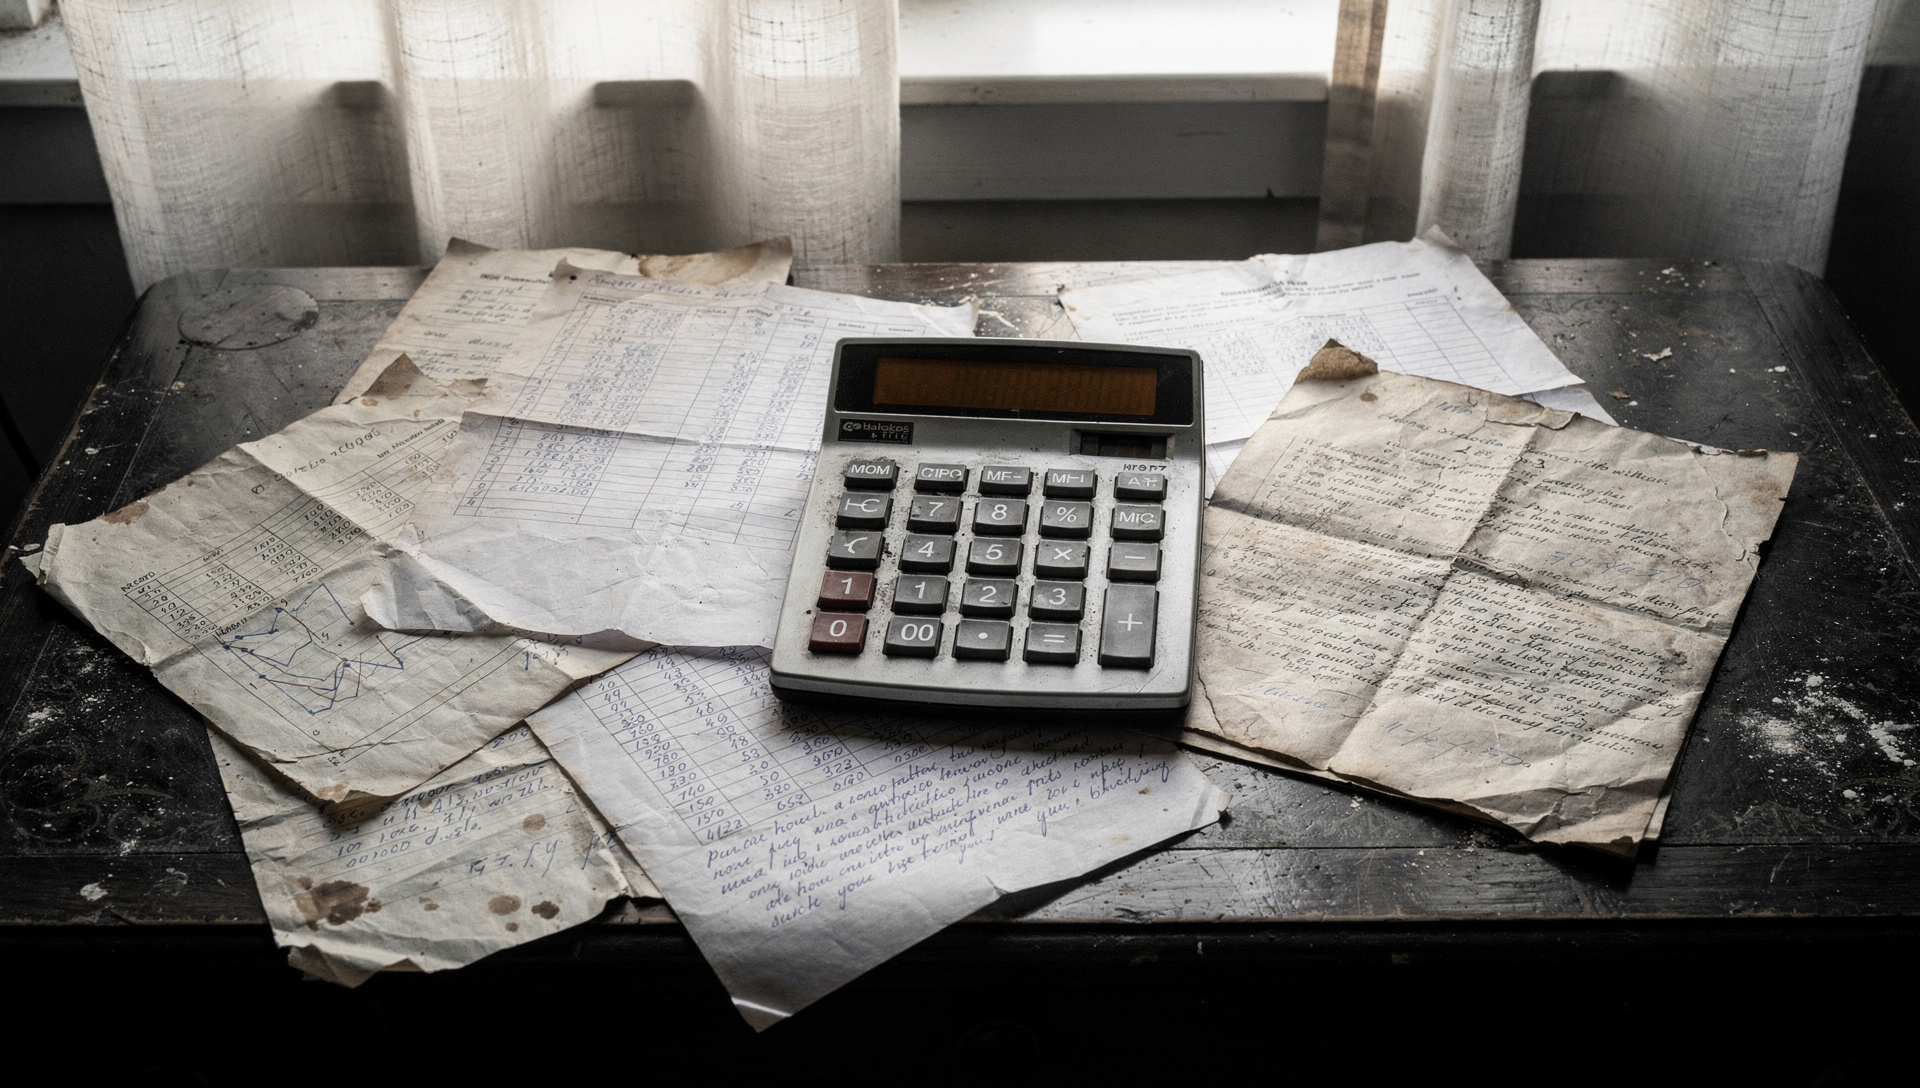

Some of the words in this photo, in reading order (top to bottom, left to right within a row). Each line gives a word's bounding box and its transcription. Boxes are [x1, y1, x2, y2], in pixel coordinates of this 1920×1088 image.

[851, 464, 890, 475] MOM
[929, 501, 944, 517] 7
[991, 504, 1008, 520] 8
[918, 541, 935, 558] 4
[985, 544, 1004, 560] 5
[841, 577, 852, 595] 1
[914, 581, 926, 599] 1
[979, 585, 997, 603] 2
[1050, 588, 1066, 605] 3
[829, 619, 848, 637] 0
[900, 623, 934, 641] 00
